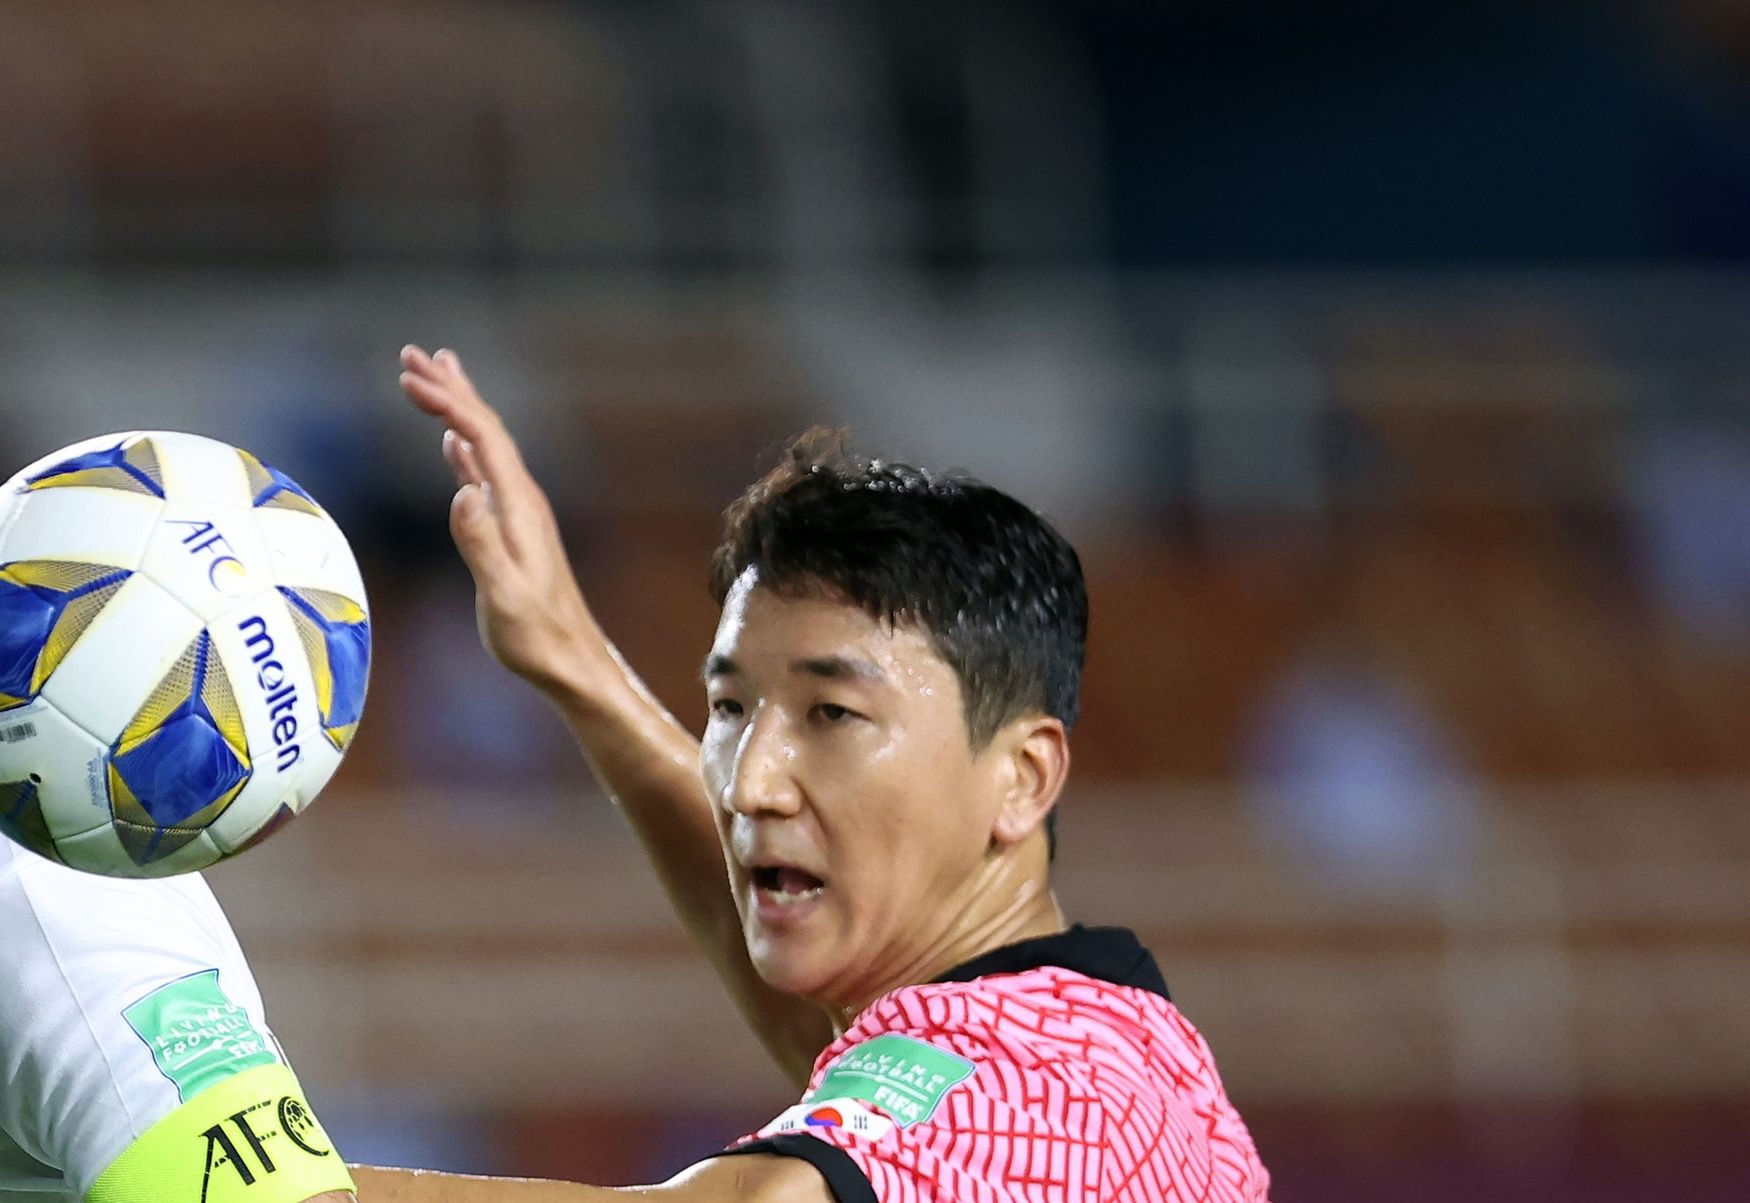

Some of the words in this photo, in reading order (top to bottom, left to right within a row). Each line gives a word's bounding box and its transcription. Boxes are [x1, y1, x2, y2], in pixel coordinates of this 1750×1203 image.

[165, 520, 246, 592] AFC
[238, 615, 301, 774] molten
[873, 1085, 921, 1121] FIFA
